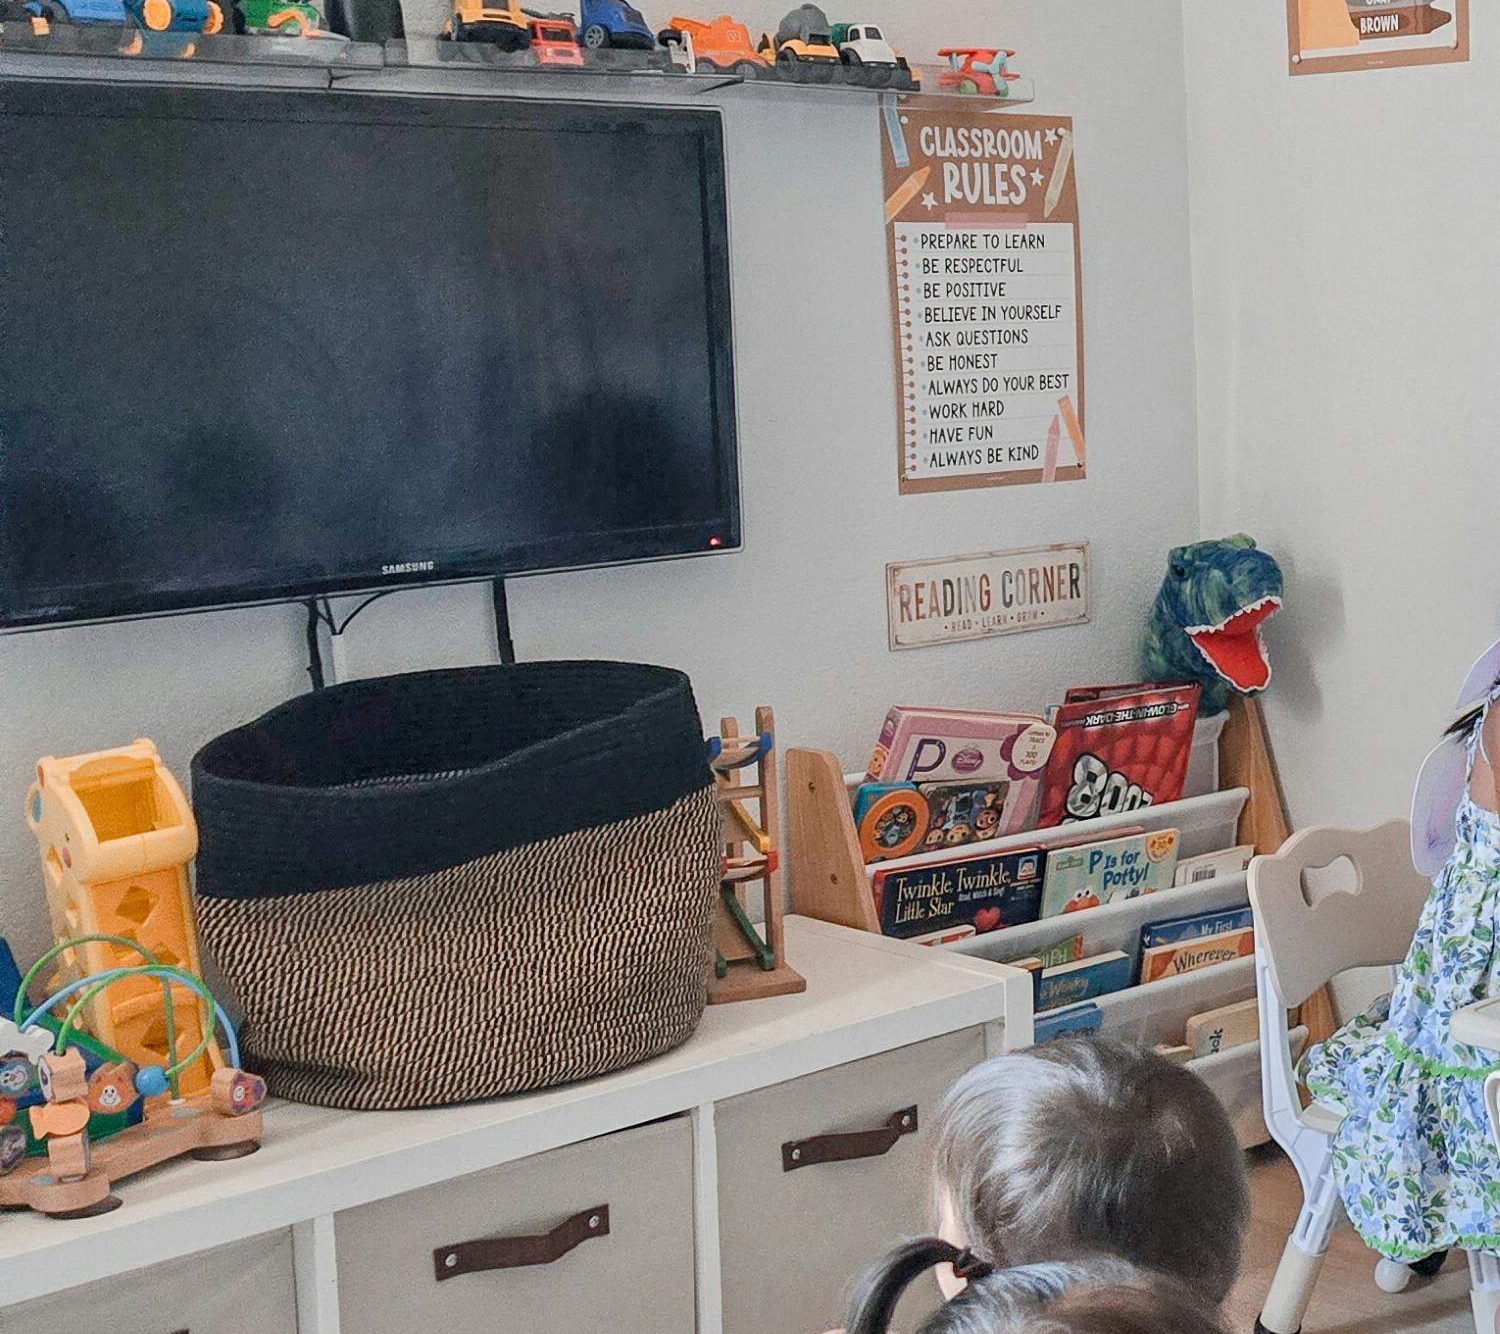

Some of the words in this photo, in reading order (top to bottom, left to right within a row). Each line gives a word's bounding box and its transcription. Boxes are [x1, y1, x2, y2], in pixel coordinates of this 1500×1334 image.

[1359, 12, 1400, 34] BROWN
[919, 125, 1043, 161] CLASSROOM
[943, 162, 1027, 206] RULES
[920, 233, 978, 250] PREPARE
[983, 233, 1000, 250] TO
[1004, 233, 1046, 250] LEARN
[921, 258, 940, 275] BE
[944, 257, 1024, 274] RESPECTFUL
[923, 282, 941, 299] BE
[945, 282, 1007, 298] POSITIVE
[924, 306, 978, 324] BELIEVE
[981, 306, 998, 322] IN
[1000, 304, 1063, 321] YOURSELF
[925, 331, 952, 348] ASK
[955, 328, 1029, 348] QUESTIONS
[926, 355, 945, 372] BE
[948, 353, 999, 370] HONEST
[928, 379, 979, 396] ALWAYS
[981, 378, 999, 394] DO
[1002, 375, 1036, 393] YOUR
[1038, 373, 1070, 391] BEST
[928, 403, 969, 420] WORK
[972, 400, 1005, 418] HARD
[929, 427, 966, 445] HAVE
[968, 425, 994, 443] FUN
[929, 450, 984, 469] ALWAYS
[986, 448, 1005, 464] BE
[1007, 445, 1041, 463] KIND
[381, 560, 435, 576] SAMSUNG
[898, 572, 992, 624] READING
[1000, 561, 1082, 609] CORNER
[951, 619, 973, 633] READ
[981, 615, 1009, 629] LEARN
[1088, 850, 1104, 875] P
[1103, 855, 1117, 870] Is
[1120, 850, 1141, 865] for
[896, 872, 954, 903] Twinkle,
[956, 861, 1012, 893] Twinkle,
[1103, 862, 1150, 891] Potty!
[894, 900, 926, 924] Little
[928, 896, 955, 919] Star
[1200, 924, 1214, 936] My
[1215, 920, 1233, 933] First
[1173, 948, 1237, 975] Wherever
